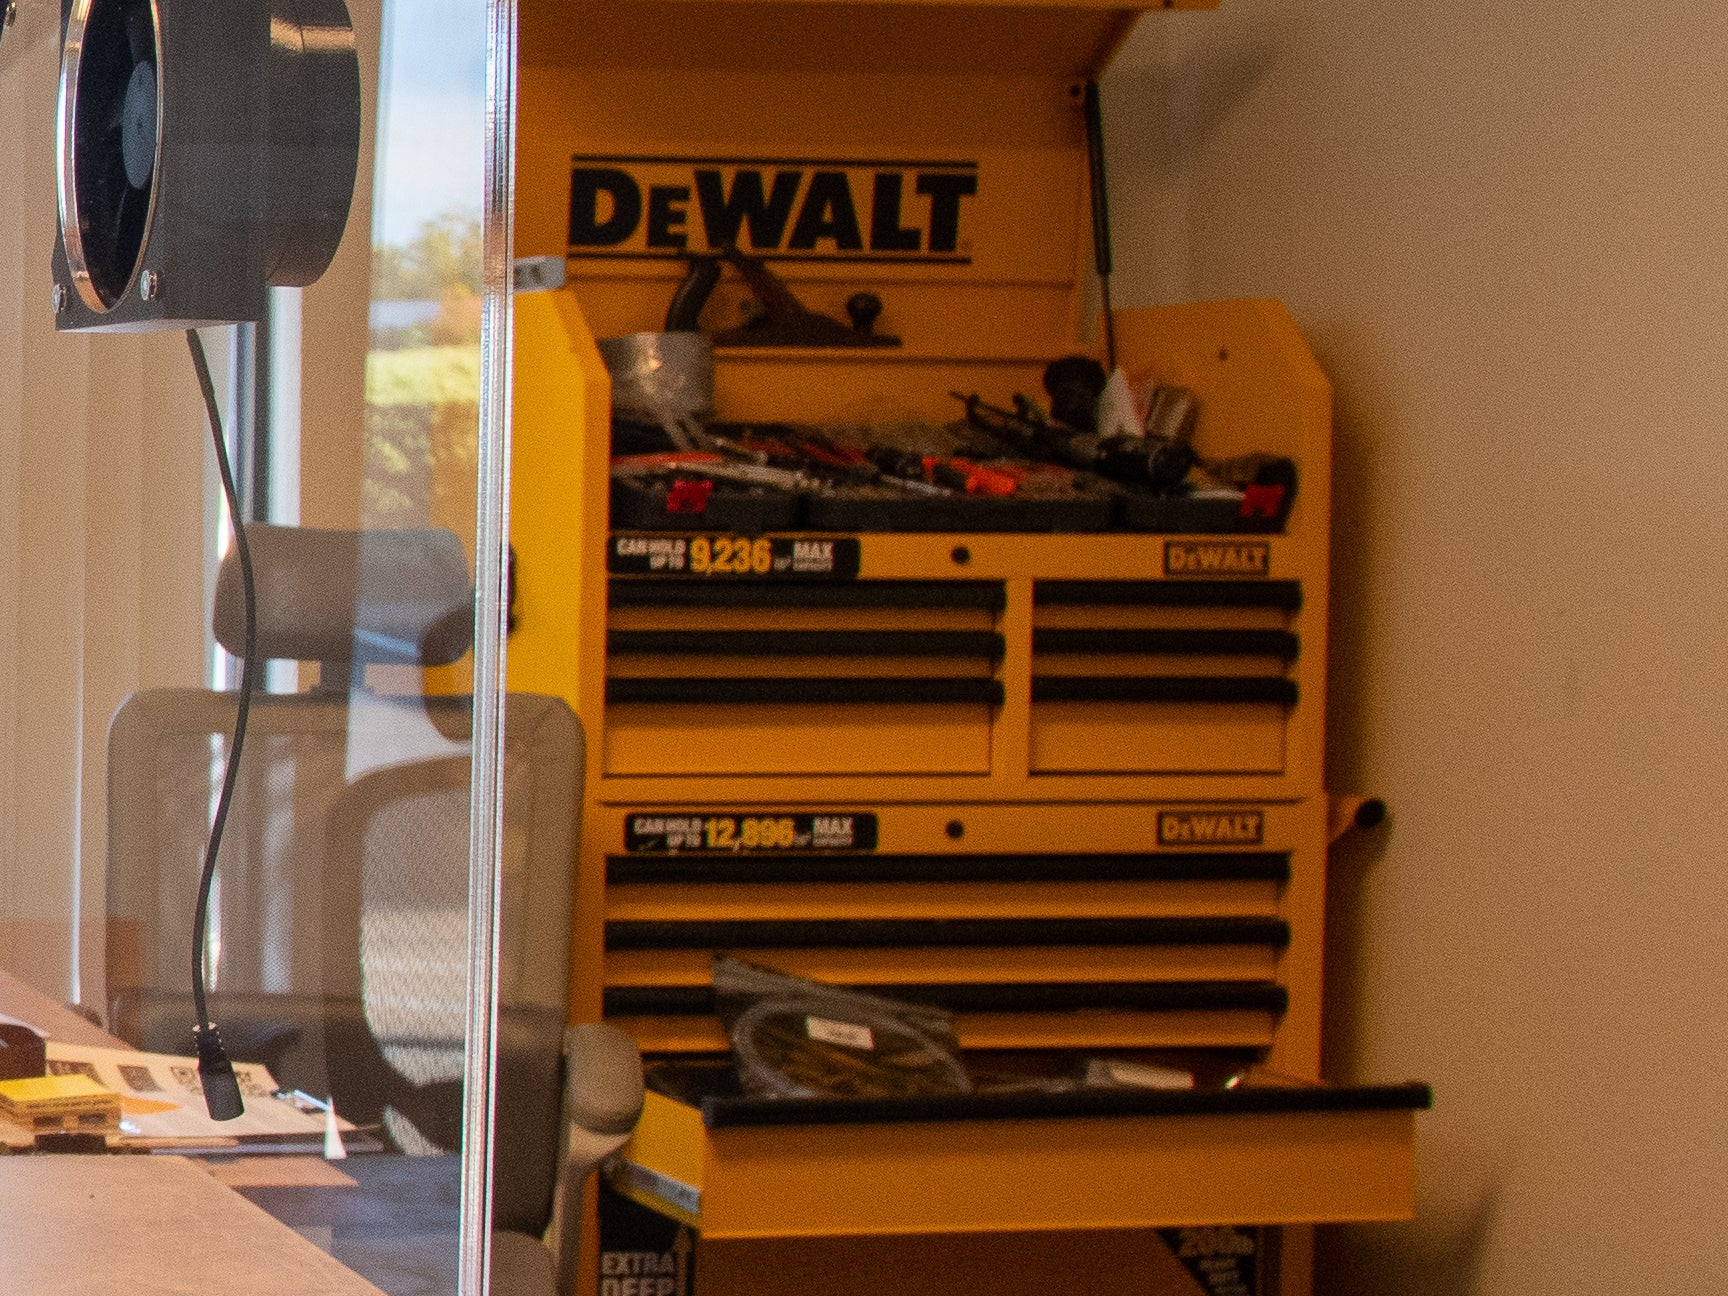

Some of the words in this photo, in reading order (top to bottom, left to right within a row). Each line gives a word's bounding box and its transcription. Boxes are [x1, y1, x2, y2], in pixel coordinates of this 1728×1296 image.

[616, 539, 648, 555] CAN
[793, 541, 834, 558] MAX
[690, 536, 772, 576] 9,236
[633, 818, 664, 834] CAN
[813, 817, 853, 835] MAX
[601, 1251, 676, 1275] EXTRA
